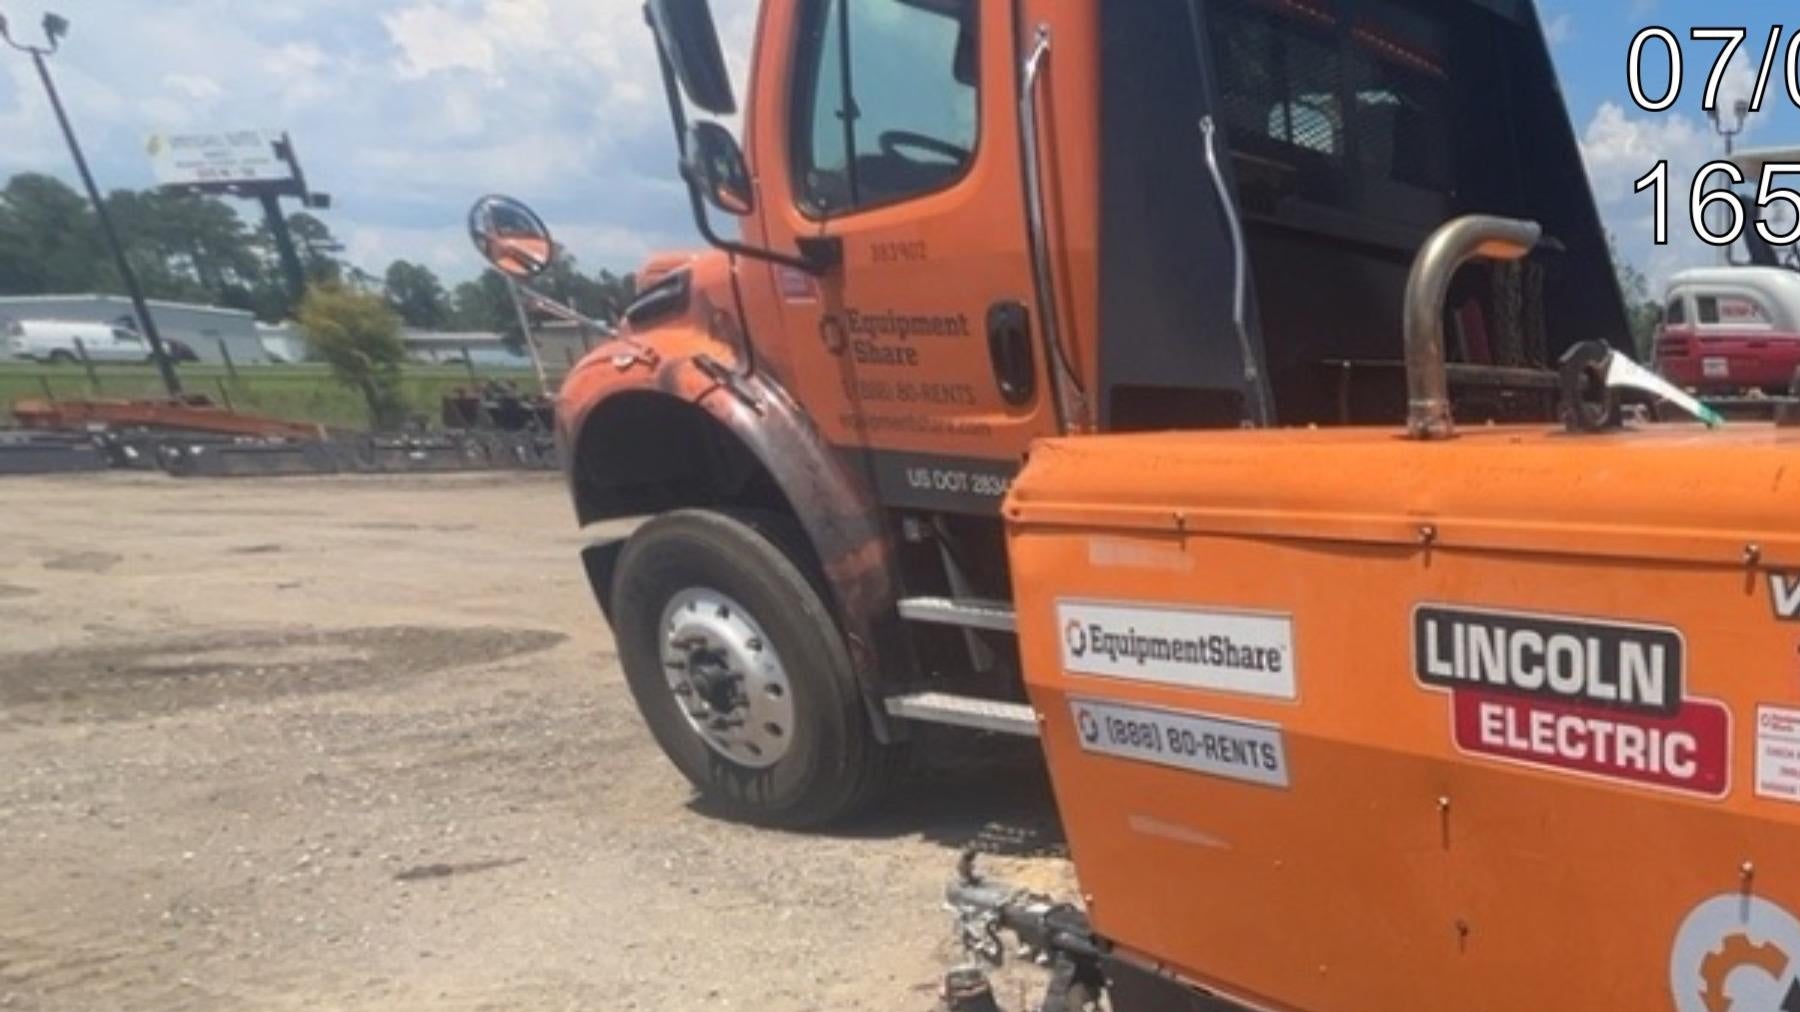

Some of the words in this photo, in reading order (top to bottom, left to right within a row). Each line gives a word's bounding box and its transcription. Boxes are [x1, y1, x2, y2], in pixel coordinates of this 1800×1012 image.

[850, 308, 970, 341] Equipment
[854, 341, 919, 367] Share
[907, 467, 932, 490] US
[934, 470, 969, 493] DOT
[1088, 623, 1284, 673] EquipmentShare
[1425, 619, 1666, 706] LINCOLN
[1105, 714, 1163, 752] (888)
[1166, 726, 1279, 771] 80-RENTS
[1479, 701, 1698, 779] ELECTRIC
